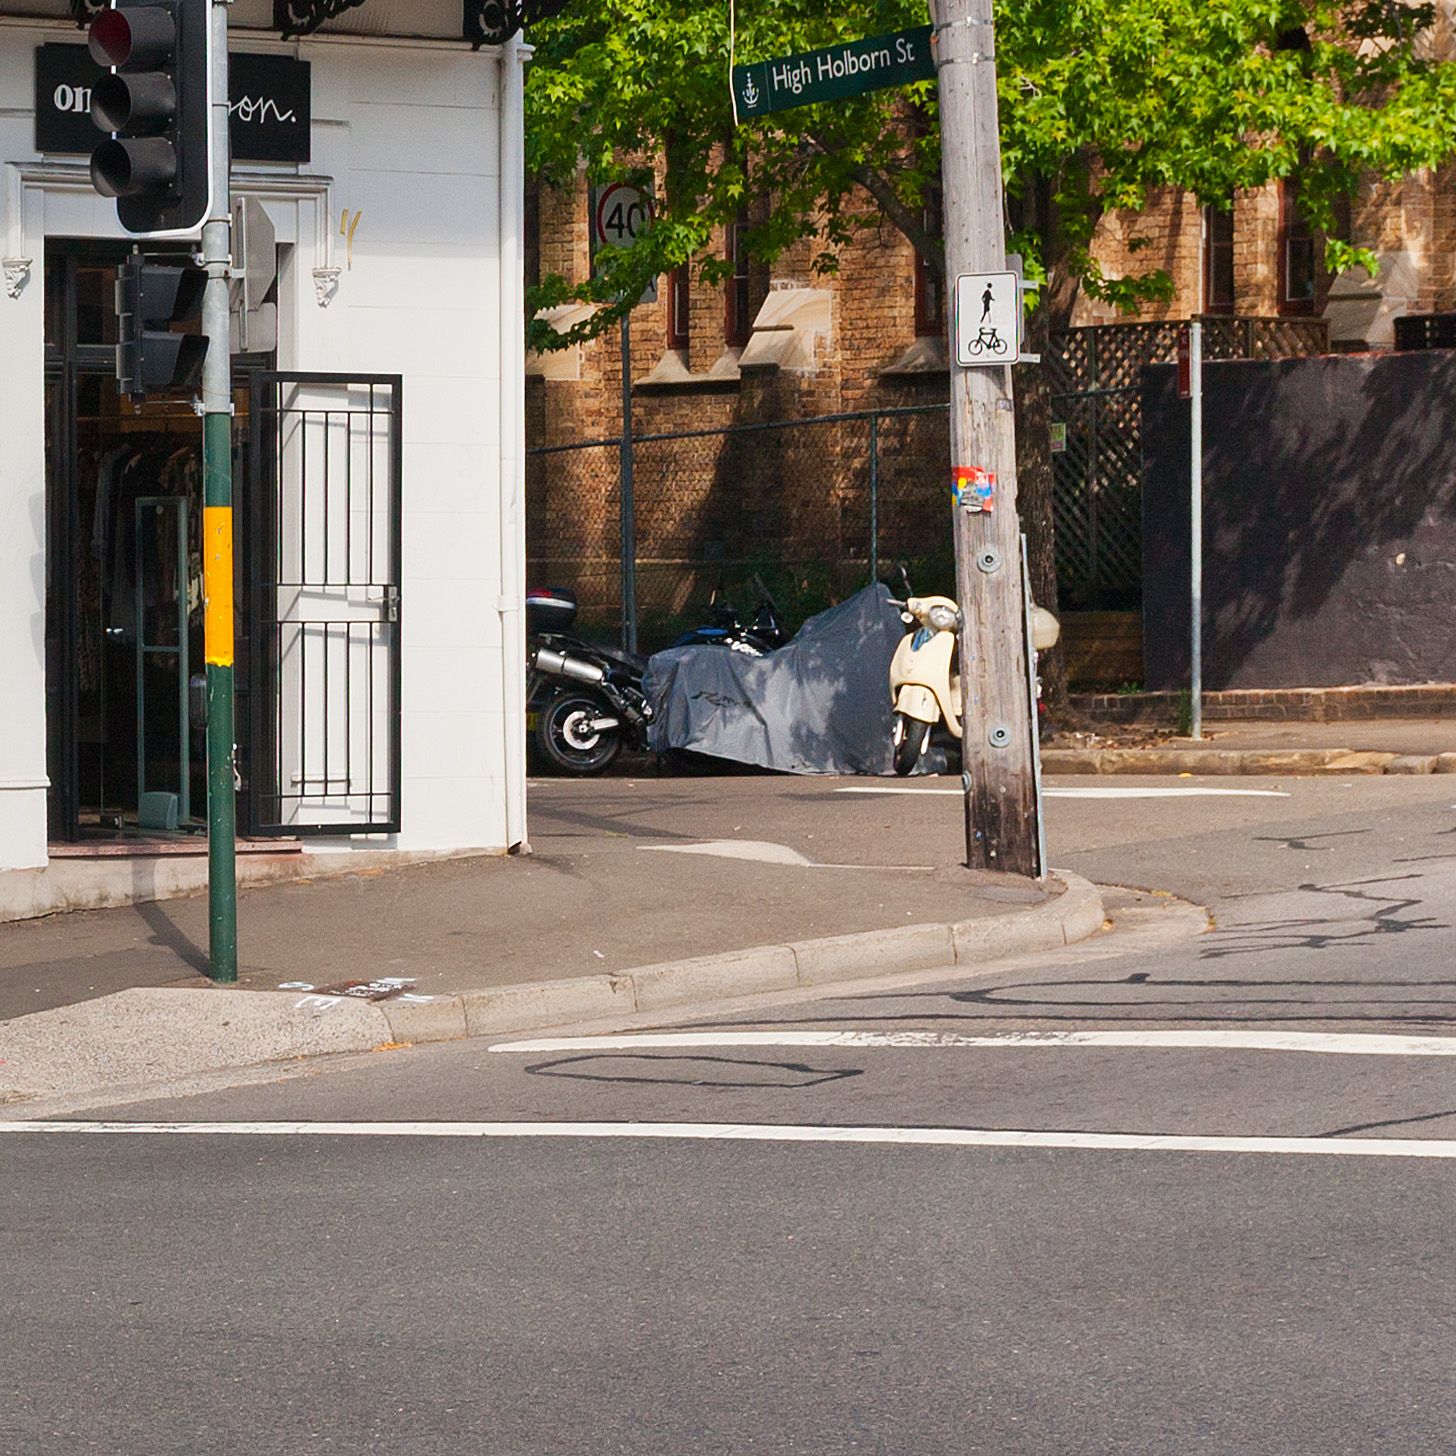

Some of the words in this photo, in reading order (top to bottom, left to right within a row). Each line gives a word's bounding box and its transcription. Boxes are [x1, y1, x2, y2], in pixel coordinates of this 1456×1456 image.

[772, 63, 812, 95] High
[817, 49, 891, 82] Holborn
[896, 38, 915, 63] St
[605, 202, 646, 239] 40
